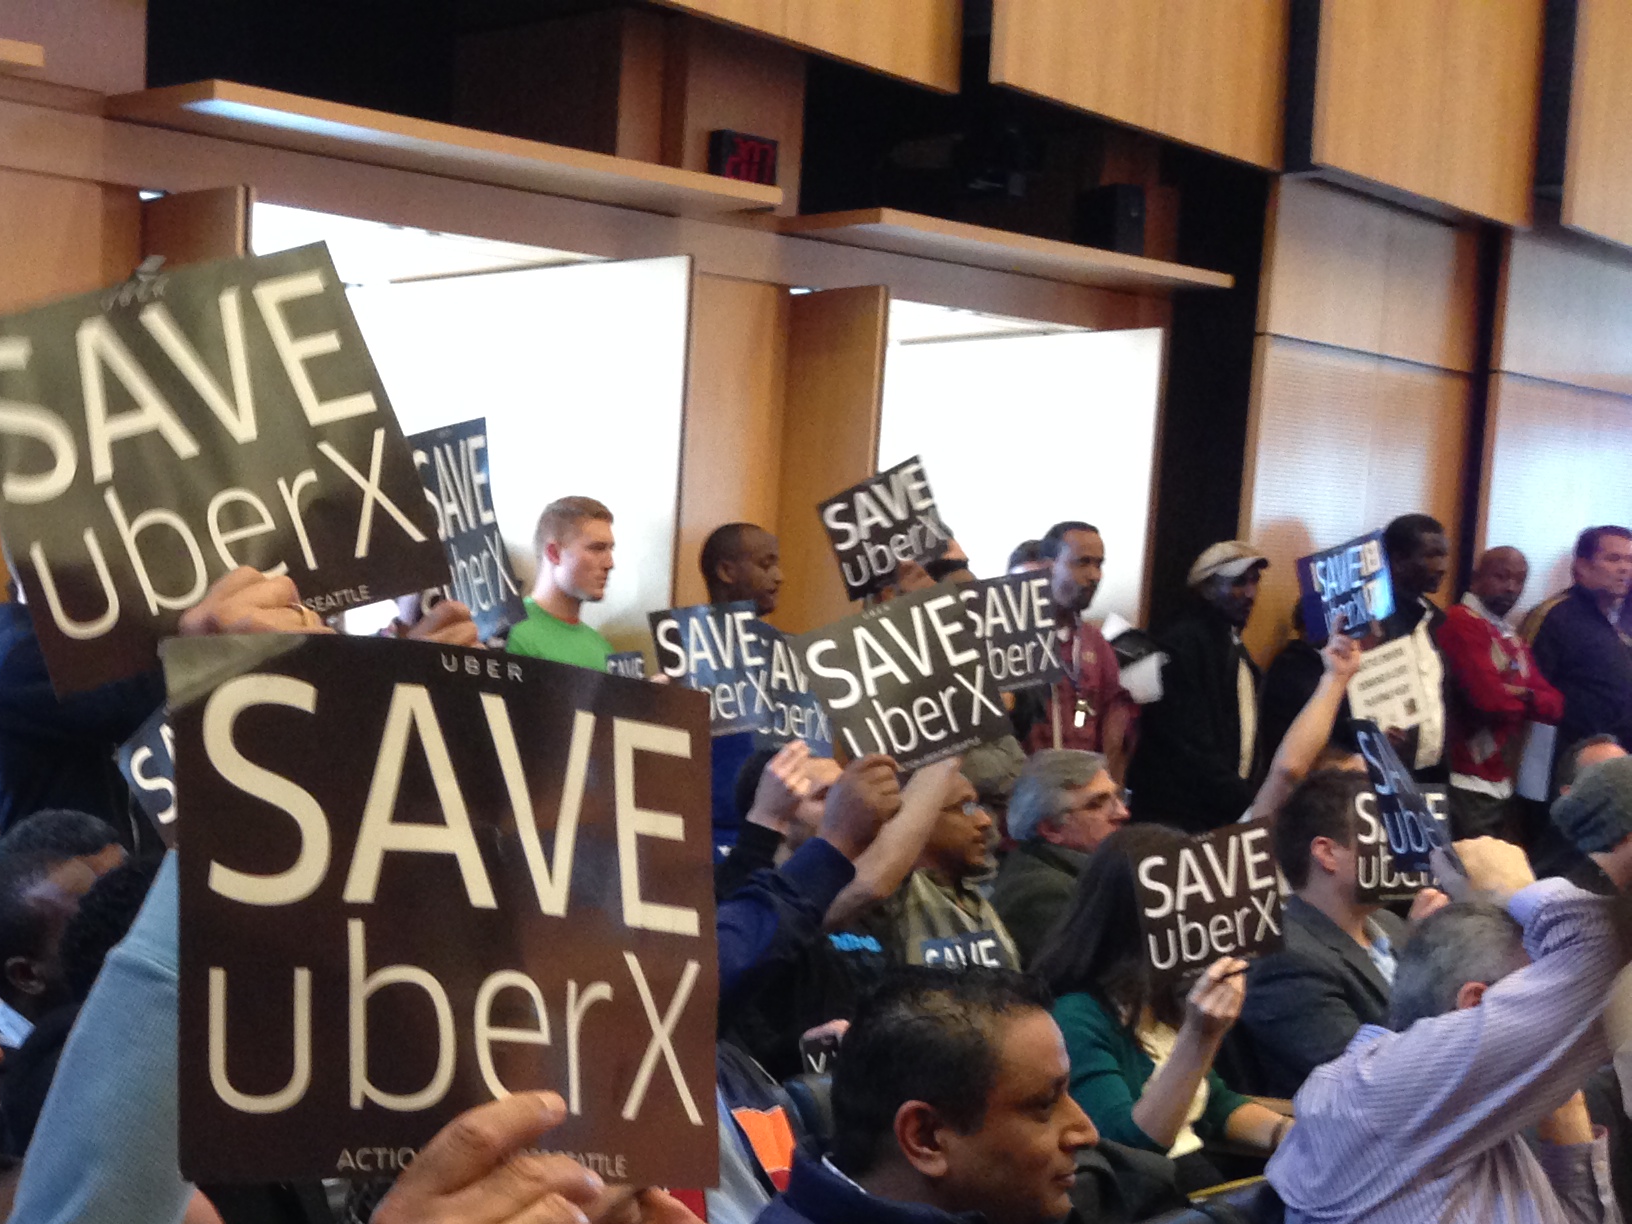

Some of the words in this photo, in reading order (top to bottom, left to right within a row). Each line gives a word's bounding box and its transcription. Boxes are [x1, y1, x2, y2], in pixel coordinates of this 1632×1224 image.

[29, 427, 428, 641] uberX
[822, 463, 935, 552] SAVE
[841, 505, 951, 587] uberX
[440, 652, 524, 683] UBER
[656, 610, 768, 678] SAVE
[804, 594, 981, 710] SAVE
[986, 629, 1061, 681] berX
[690, 668, 776, 721] erX
[841, 664, 1004, 760] uberX
[201, 672, 701, 937] SAVE
[1136, 827, 1276, 920] SAVE
[1147, 890, 1282, 970] uberX
[207, 917, 704, 1127] uberX
